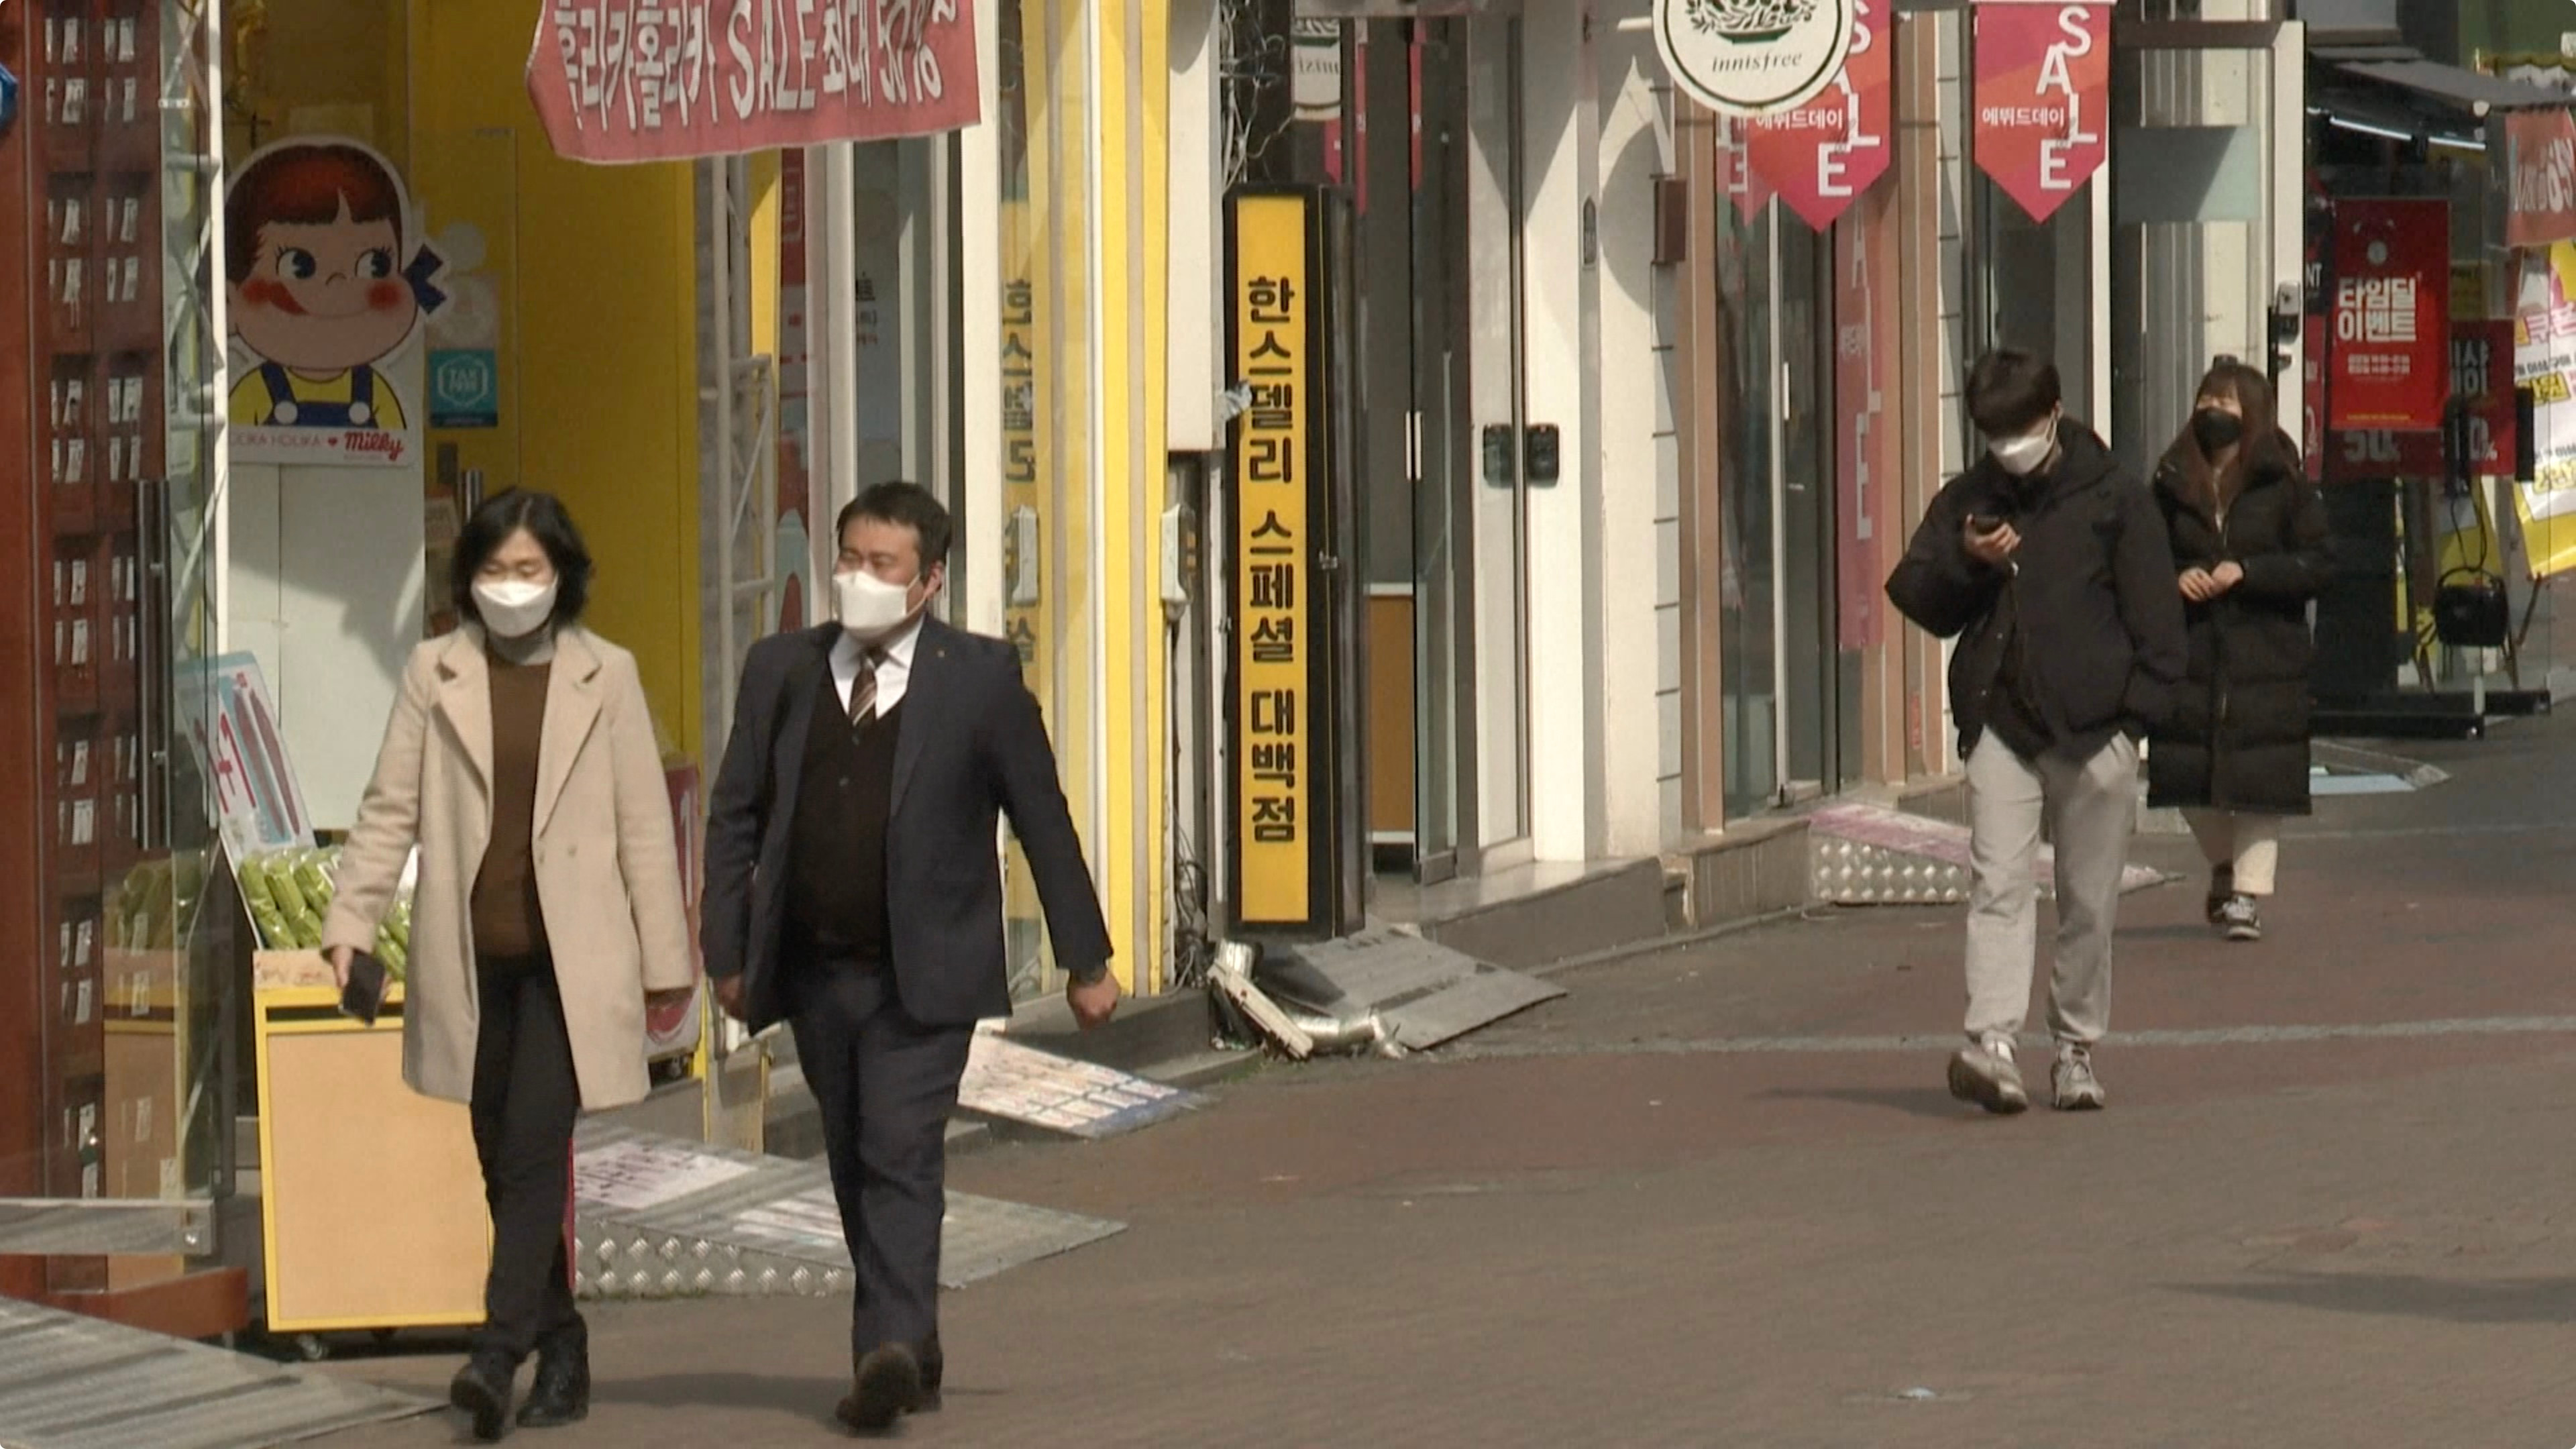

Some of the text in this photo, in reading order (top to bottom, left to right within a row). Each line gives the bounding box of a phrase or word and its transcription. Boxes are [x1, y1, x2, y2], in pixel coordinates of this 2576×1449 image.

[728, 0, 816, 119] SALE
[1712, 52, 1803, 73] innisfree
[2035, 5, 2098, 189] SALE
[2338, 276, 2416, 309] 타임딜
[2337, 310, 2416, 342] 이벤트
[344, 431, 404, 461] Milky
[1248, 276, 1295, 843] 한스델리 스페셜 대백점
